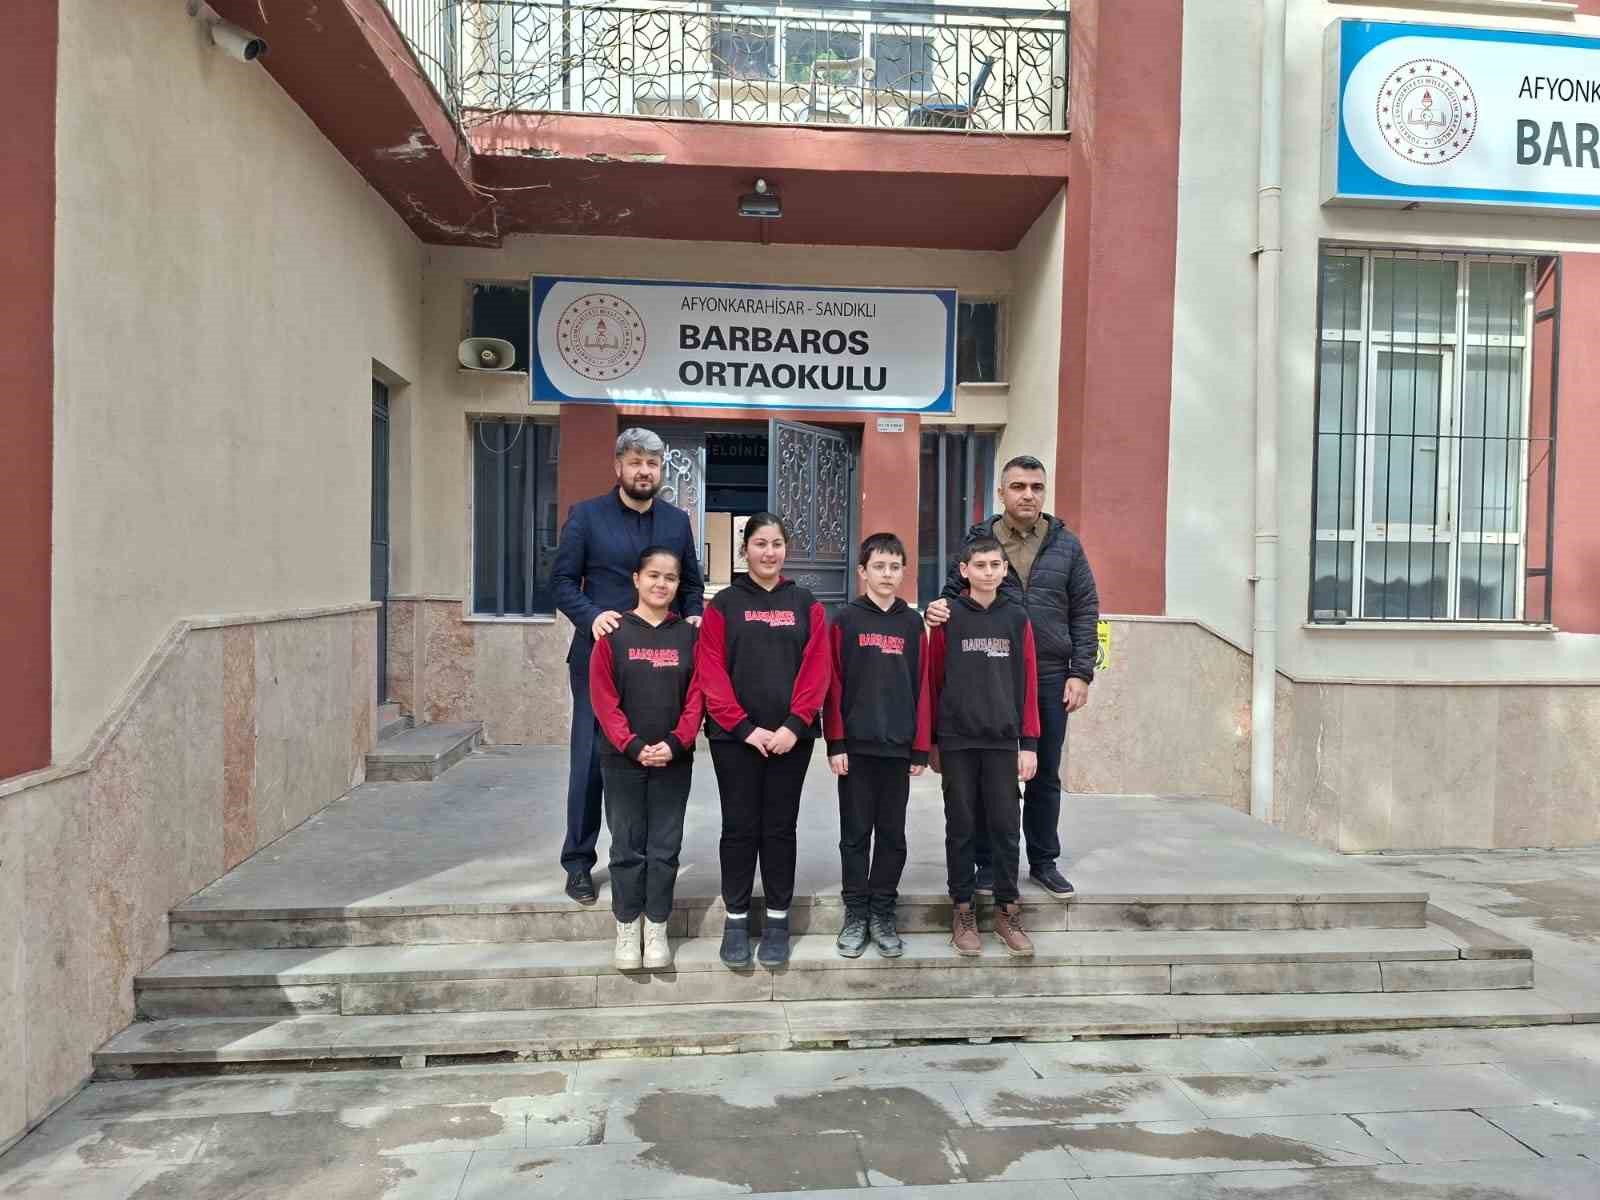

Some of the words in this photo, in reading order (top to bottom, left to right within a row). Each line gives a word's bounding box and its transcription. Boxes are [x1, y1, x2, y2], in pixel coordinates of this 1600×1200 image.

[1518, 75, 1600, 103] AFYONK
[1516, 118, 1600, 168] BAR
[680, 296, 805, 316] AFYONKARAHİSAR
[815, 301, 876, 318] SANDIKLI
[679, 324, 870, 355] BARBAROS
[678, 360, 888, 392] ORTAOKULU
